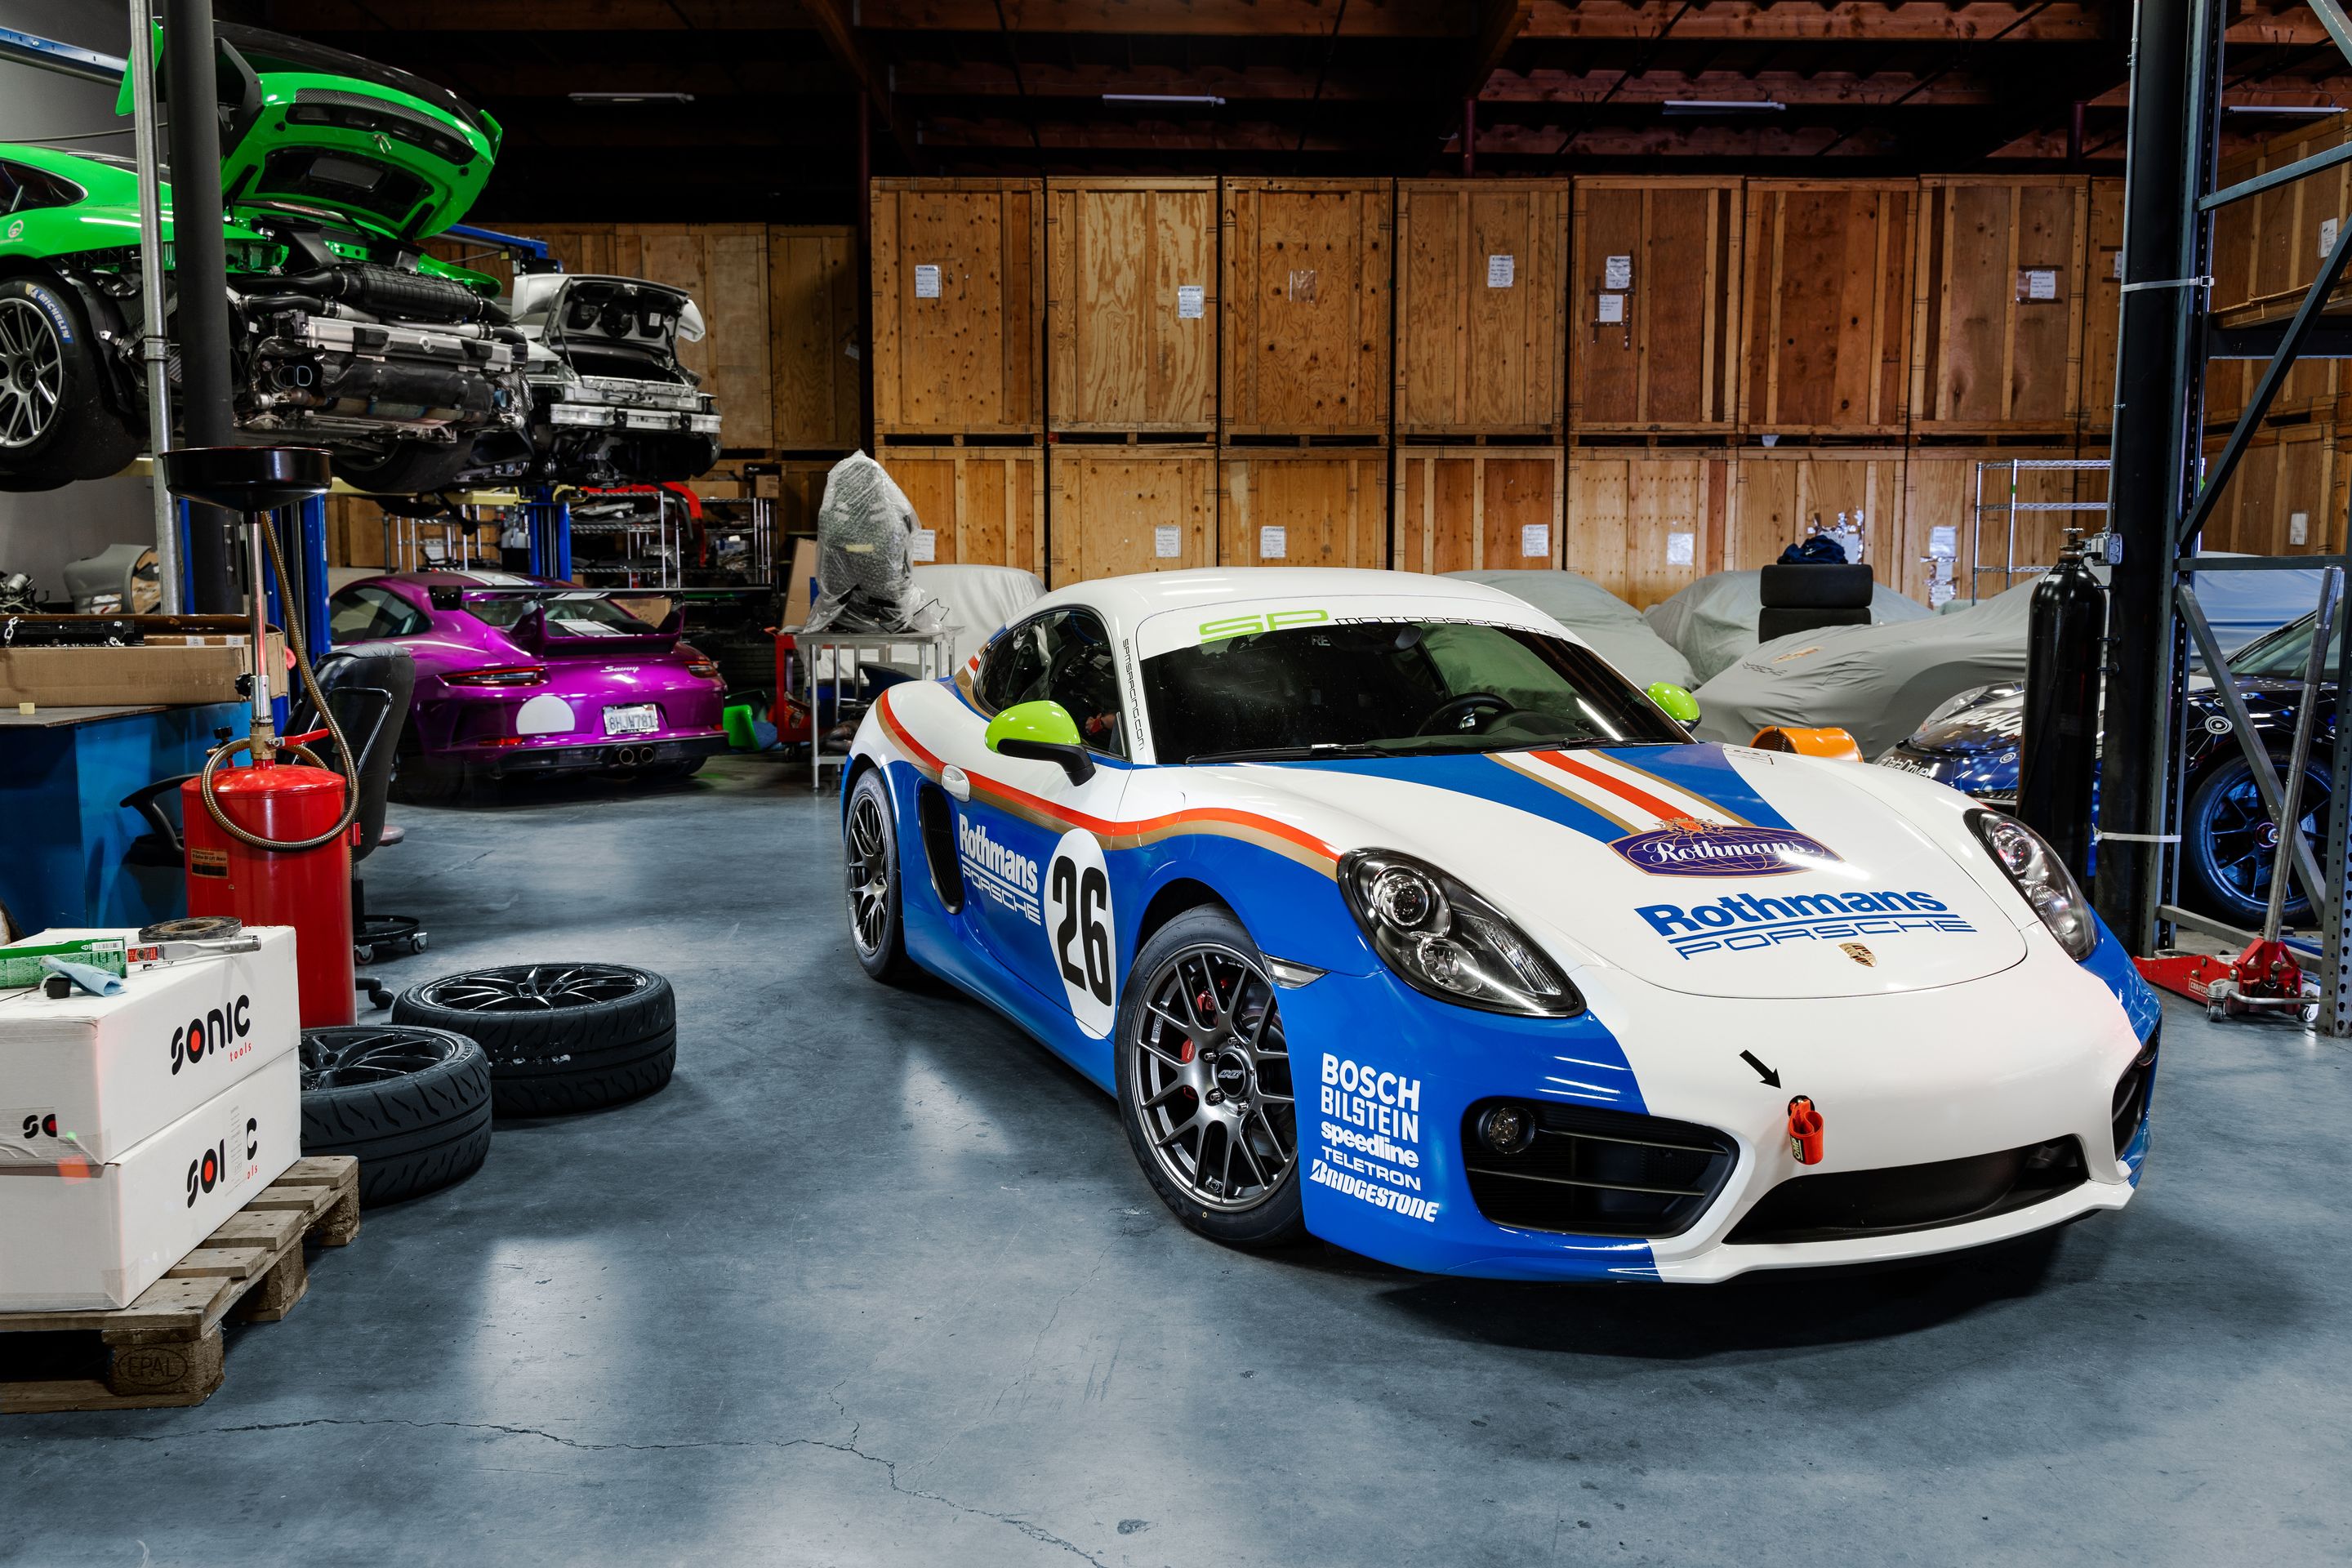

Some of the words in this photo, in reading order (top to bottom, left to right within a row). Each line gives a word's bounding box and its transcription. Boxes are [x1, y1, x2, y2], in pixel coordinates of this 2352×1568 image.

[38, 293, 70, 339] MICHELIN
[1199, 609, 1329, 643] SP
[959, 813, 1038, 894] Rothmans
[1642, 839, 1814, 864] Rothmans
[962, 864, 1041, 926] PORSCHE
[1633, 890, 1948, 937] Rothmans
[1053, 855, 1112, 1006] 26
[1675, 920, 1977, 960] PORSCHE
[171, 995, 251, 1076] SONIC
[229, 1042, 252, 1062] tools
[1322, 1052, 1421, 1112] BOSCH
[1321, 1085, 1419, 1143] BILSTEIN
[187, 1117, 257, 1209] SOC
[1321, 1120, 1419, 1169] speedline
[1321, 1145, 1421, 1192] TELETRON
[1791, 1137, 1802, 1160] OMP
[1309, 1158, 1440, 1223] BRIDGESTONE
[128, 1356, 178, 1378] EPAL
